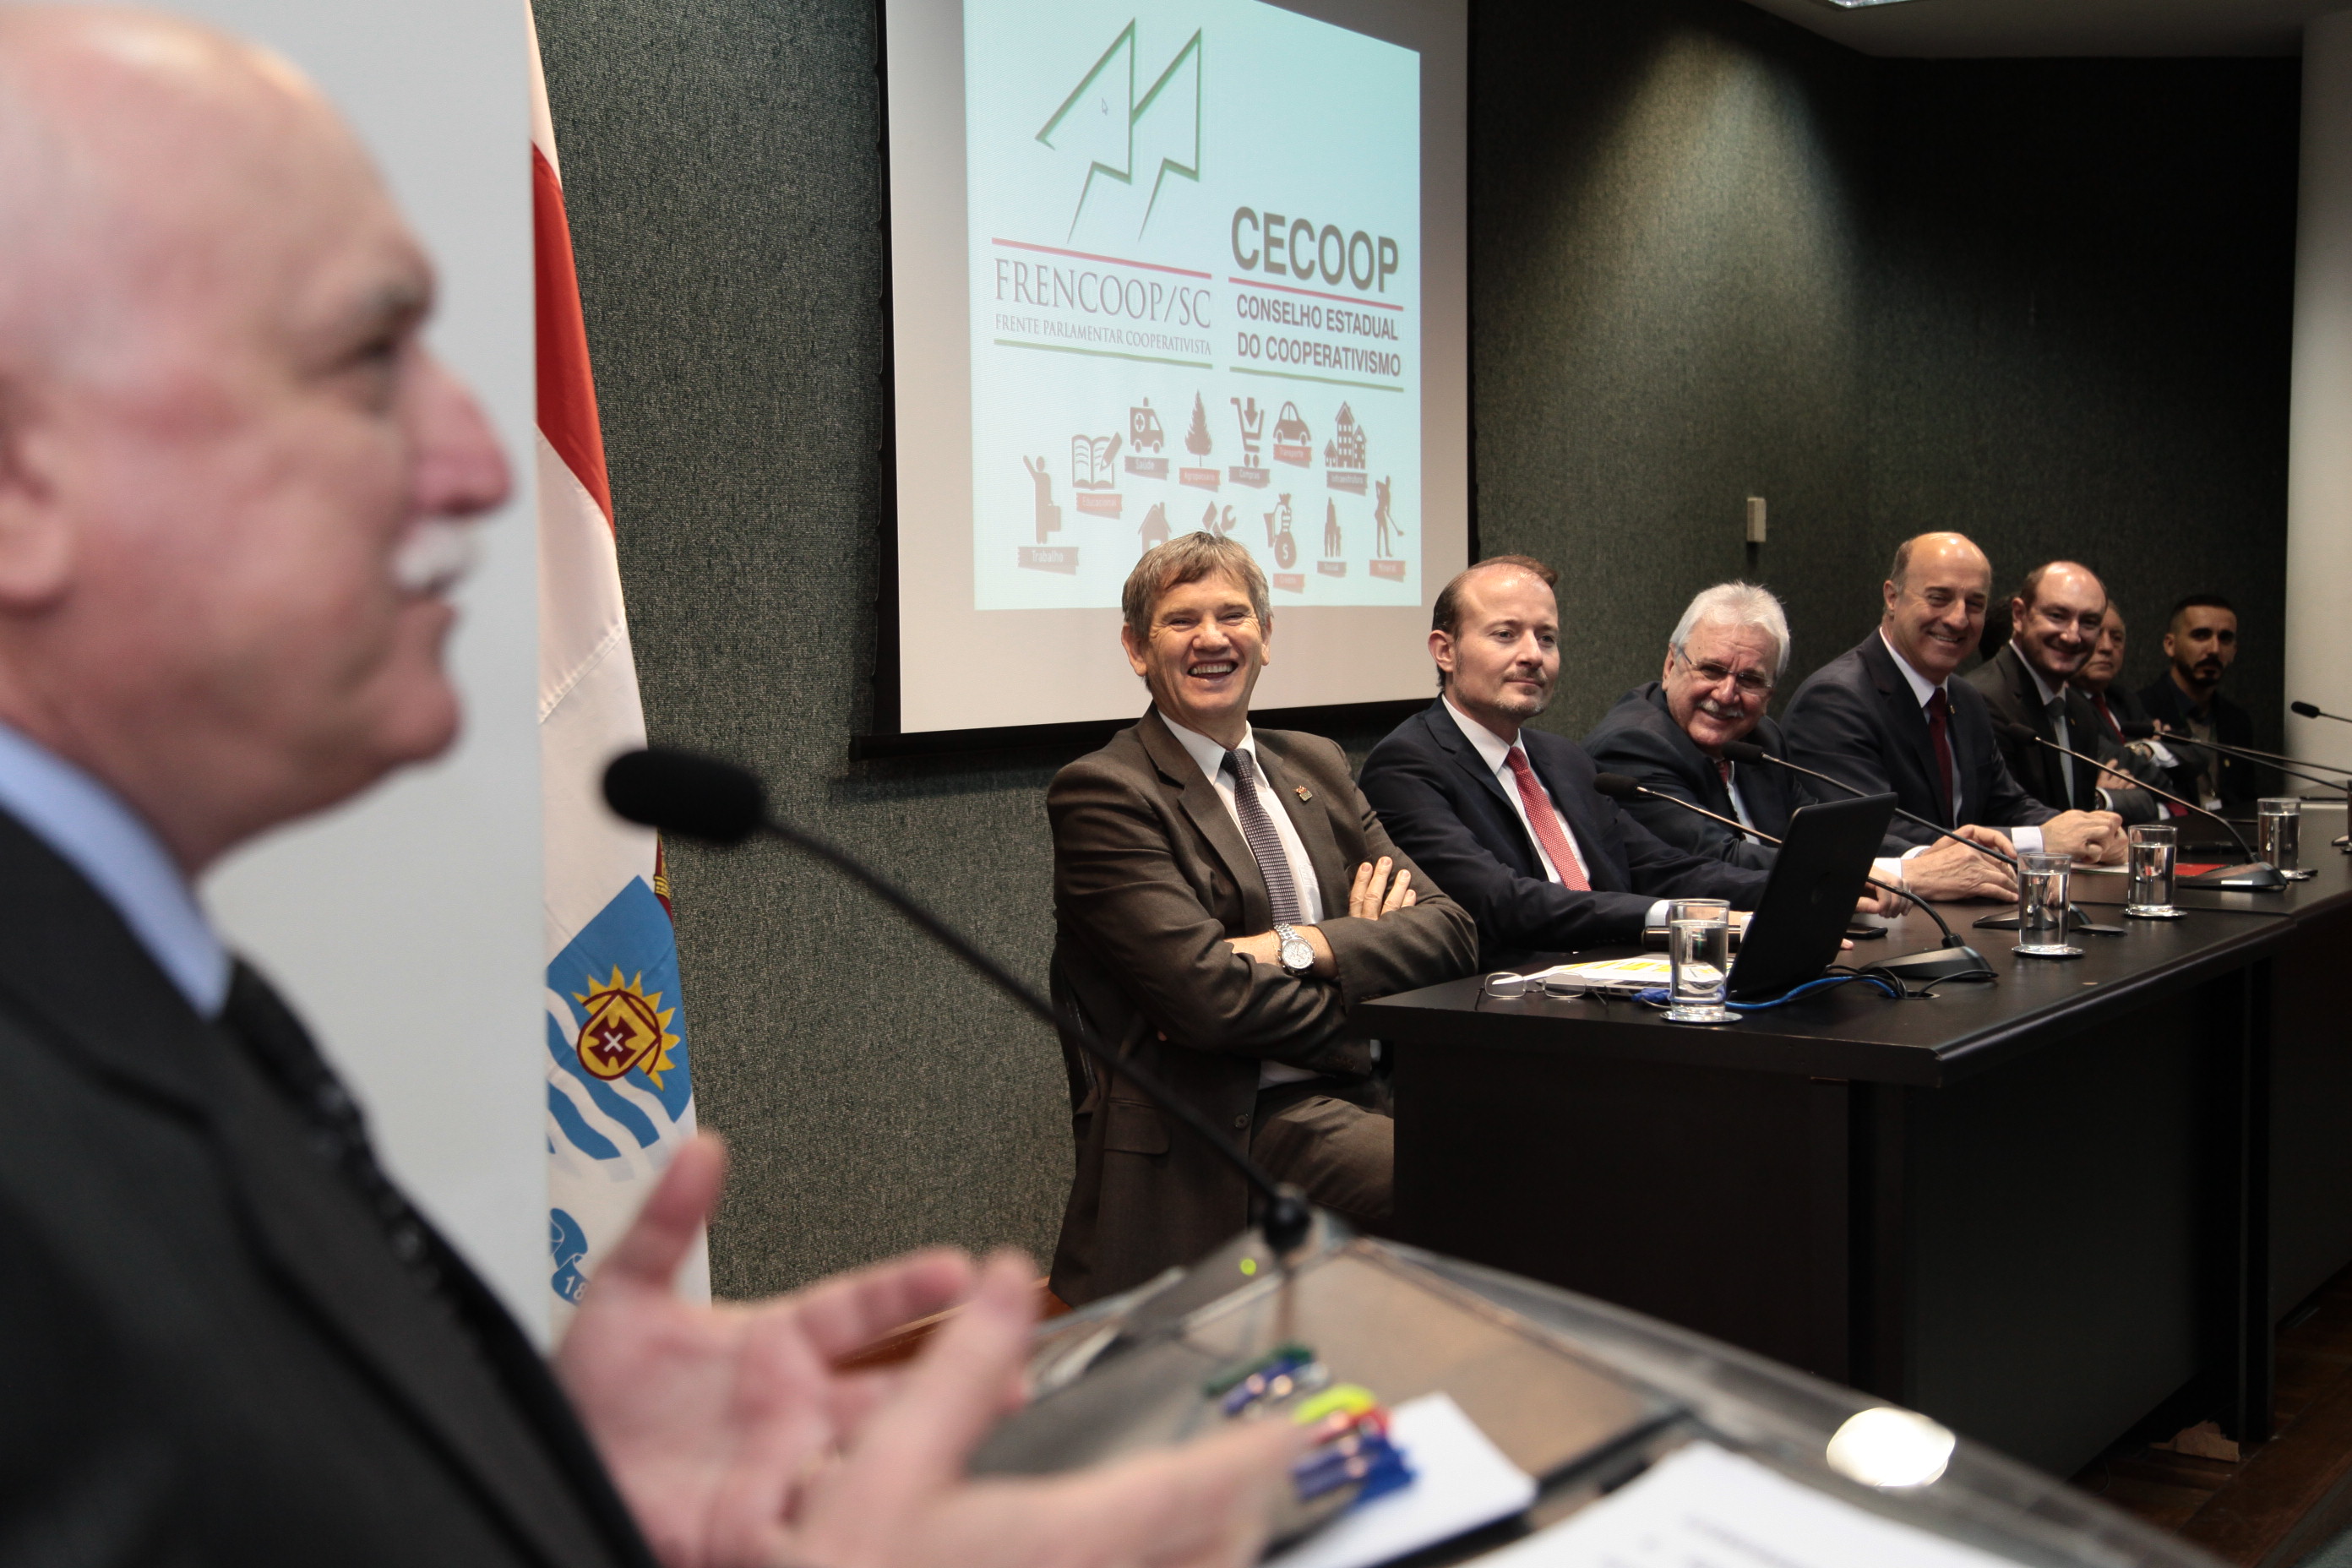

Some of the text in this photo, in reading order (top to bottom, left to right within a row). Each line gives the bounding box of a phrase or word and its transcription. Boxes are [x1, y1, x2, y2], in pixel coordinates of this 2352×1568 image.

[1231, 206, 1399, 293] CECOOP
[994, 258, 1211, 329] FRENCOOP/SC
[1237, 293, 1399, 340] CONSELHO ESTADUAL
[995, 313, 1211, 355] FRENTE PARLAMENTAR COOPERATIVISTA
[1238, 331, 1401, 377] DO COOPERATIVISMO
[1032, 550, 1064, 563] Trabalho
